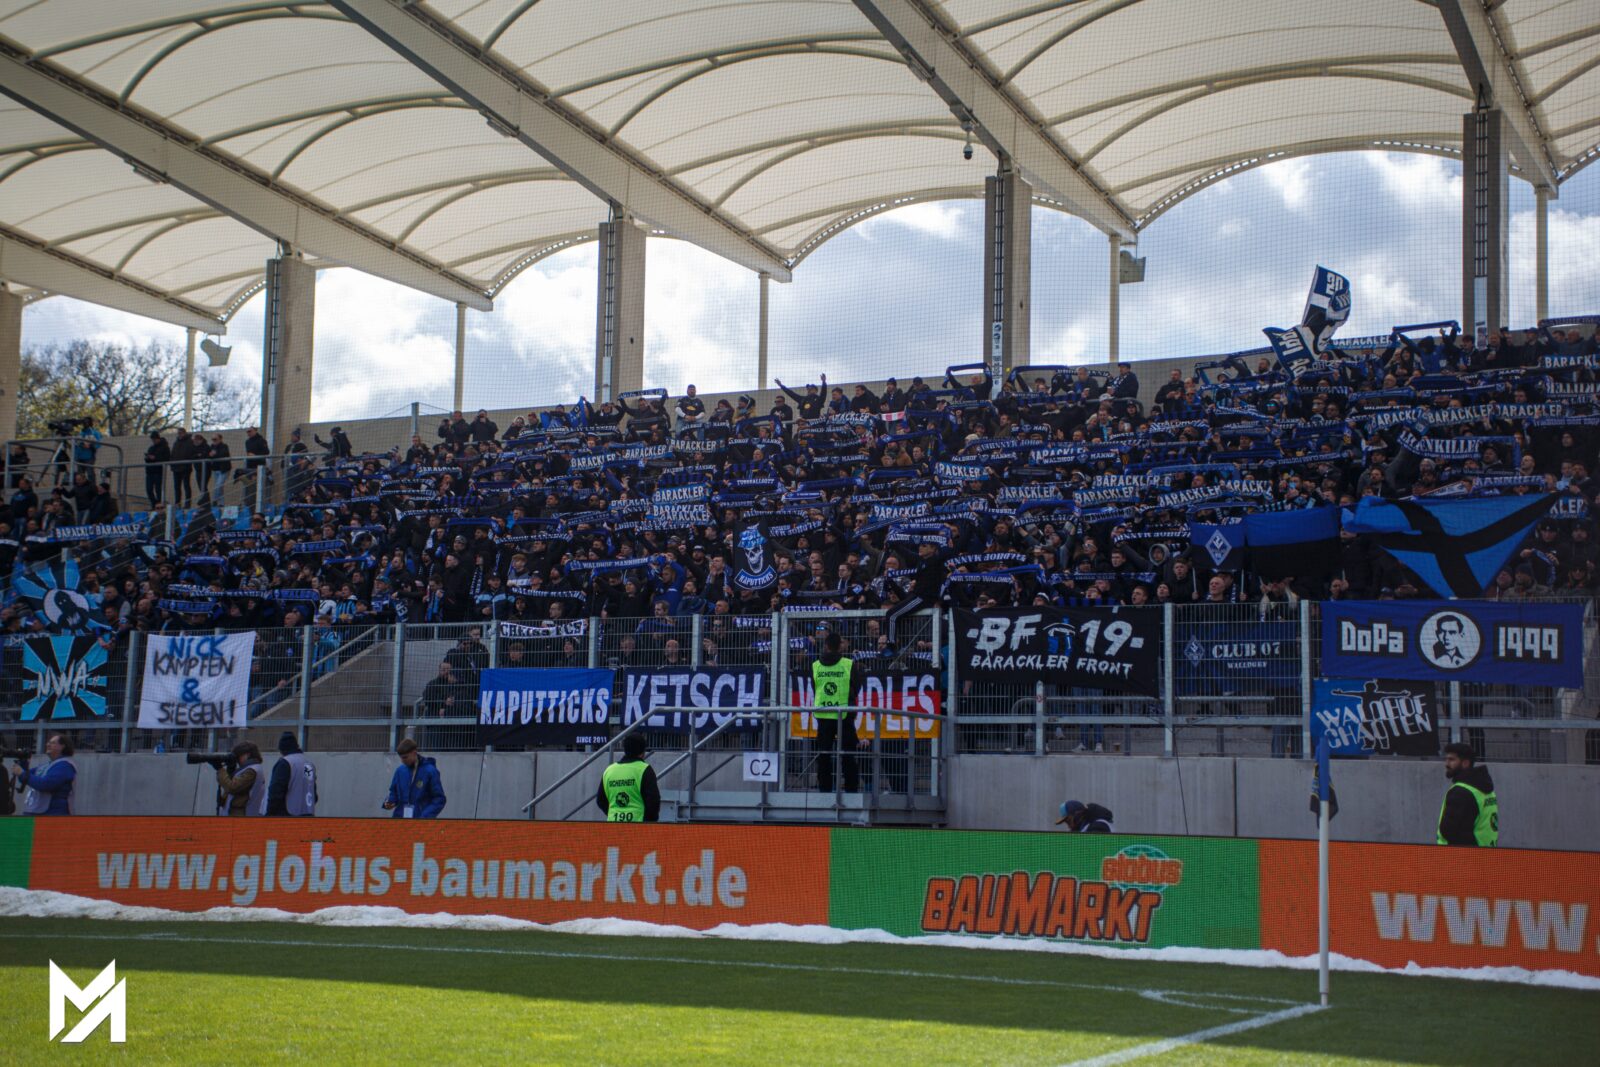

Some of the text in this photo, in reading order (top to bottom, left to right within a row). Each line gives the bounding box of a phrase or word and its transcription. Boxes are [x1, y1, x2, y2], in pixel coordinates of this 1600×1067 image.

[655, 485, 704, 502] BARACKLER
[1212, 641, 1281, 659] CLUB 07
[970, 654, 1134, 678] BARACKLER FRONT
[181, 678, 201, 703] &
[624, 673, 761, 729] KETSCH
[479, 687, 610, 725] KAPUTTICKS
[576, 736, 591, 744] SINCE
[750, 759, 772, 777] C2
[608, 778, 636, 788] SICHERHEIT
[613, 812, 634, 822] 190
[96, 839, 744, 907] www.globus-baumarkt.de
[921, 871, 1162, 943] BAUMARKT
